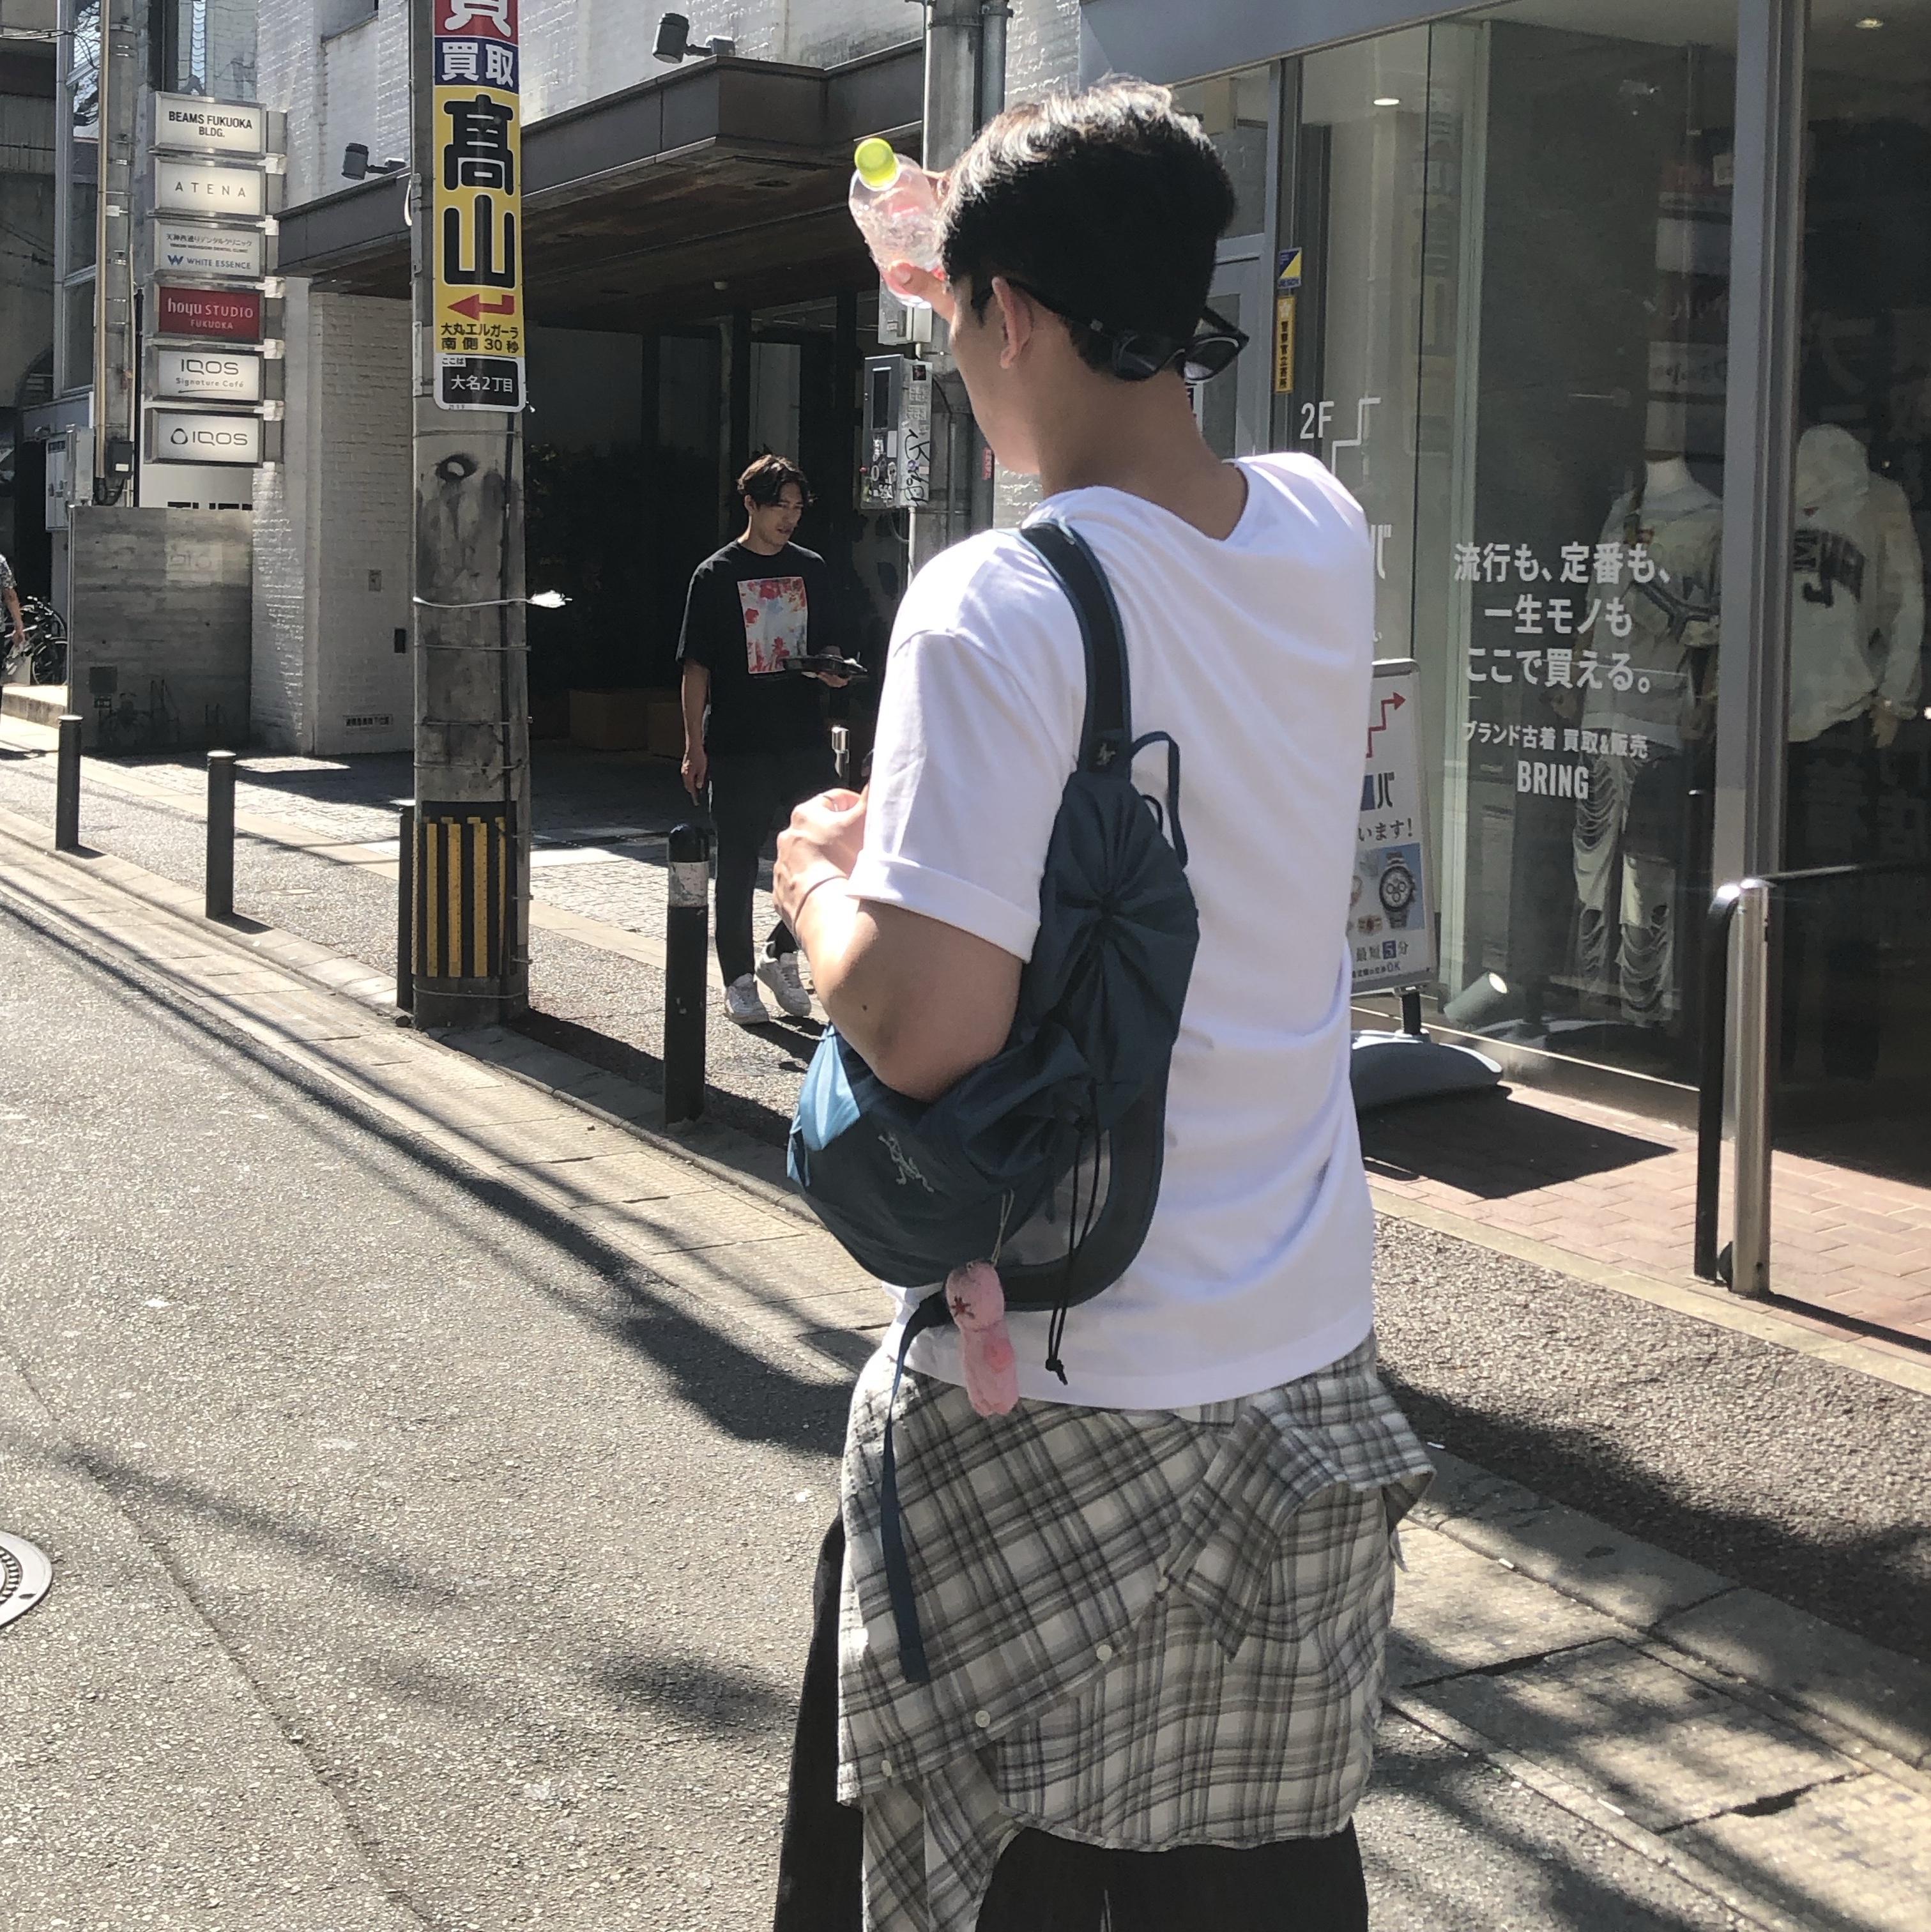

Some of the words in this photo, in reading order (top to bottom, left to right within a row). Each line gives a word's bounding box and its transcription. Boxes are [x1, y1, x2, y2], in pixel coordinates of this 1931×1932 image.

[441, 42, 513, 88] 買取
[169, 111, 204, 125] BEAMS
[207, 115, 252, 129] FUKUOKA
[199, 126, 225, 137] BLDG.
[175, 182, 246, 197] ATENA
[187, 257, 212, 266] WHITE
[215, 260, 251, 269] ESSENCE
[168, 298, 201, 316] hoyu
[205, 305, 254, 318] STUDIO
[190, 320, 233, 330] FUKUOKA
[441, 323, 519, 339] 大丸エルガーラ
[181, 359, 238, 375] IQOS
[176, 378, 219, 387] Signature
[451, 375, 513, 393] 大名2丁目
[1300, 401, 1334, 439] 2F
[193, 431, 248, 446] IQOS
[1454, 541, 1670, 585] 流行も、定番も、
[1485, 594, 1632, 637] 一生モノも
[1467, 648, 1650, 694] ここで買える。
[1462, 721, 1556, 751] ブランド古着
[1517, 760, 1589, 799] BRING
